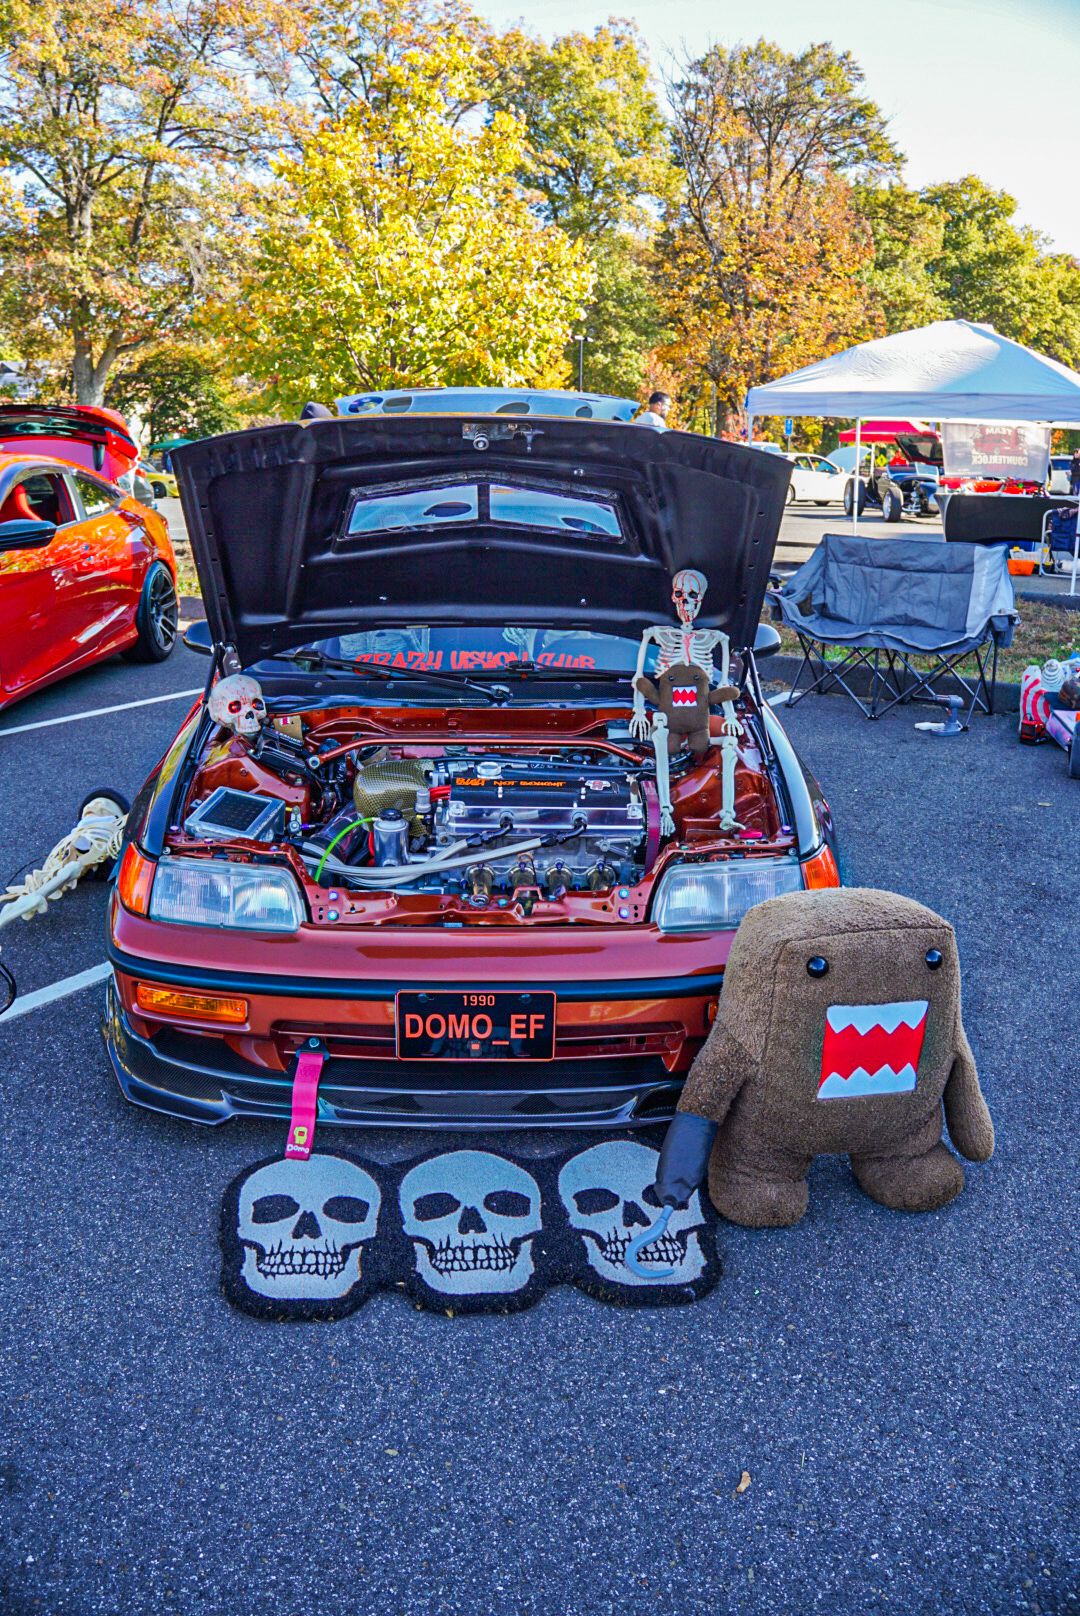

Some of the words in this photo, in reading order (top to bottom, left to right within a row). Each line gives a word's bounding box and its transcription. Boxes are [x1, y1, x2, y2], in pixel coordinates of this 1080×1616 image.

[463, 995, 495, 1006] 1990
[405, 1013, 493, 1039] DOMO
[510, 1014, 545, 1039] EF
[286, 1143, 310, 1154] Domo
